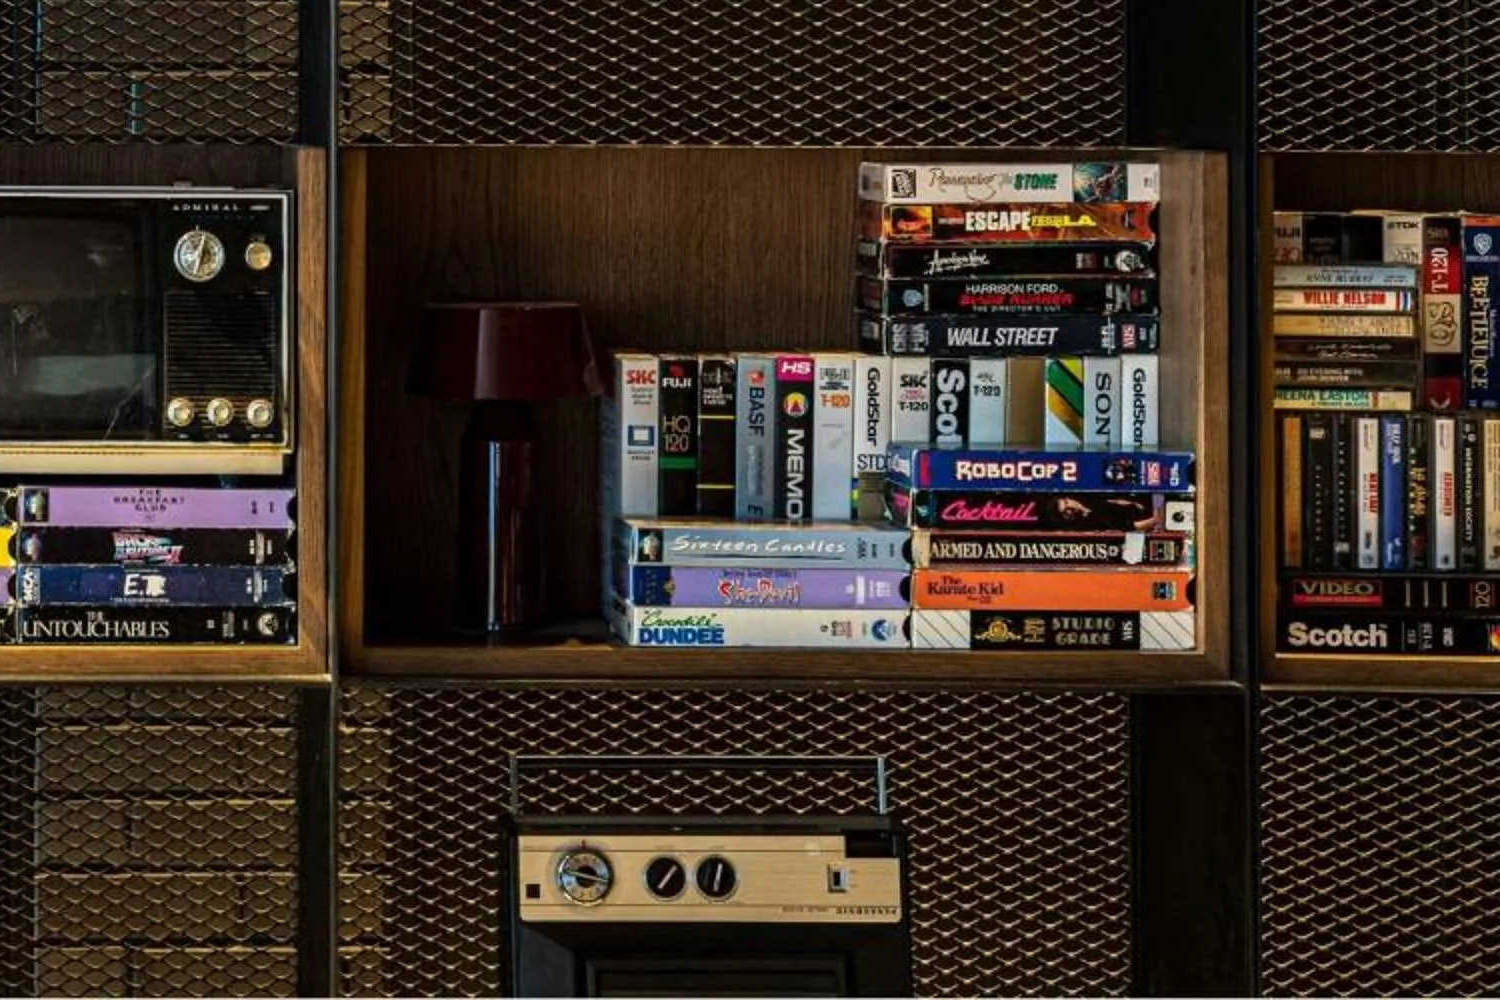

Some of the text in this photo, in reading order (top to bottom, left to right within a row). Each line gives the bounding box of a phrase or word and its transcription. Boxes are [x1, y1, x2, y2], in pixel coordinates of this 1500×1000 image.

[965, 211, 1031, 231] ESCAPE
[1064, 215, 1096, 226] L.A.
[1432, 248, 1448, 293] T-120
[966, 284, 1058, 294] HARRISON FORD
[1303, 291, 1386, 304] WILLIE NELSON
[948, 328, 1058, 346] WALL STREET
[782, 362, 811, 374] HS
[662, 377, 692, 388] FUJI
[821, 394, 850, 408] T-120
[868, 368, 880, 446] GoldStar
[900, 402, 928, 411] T-120
[748, 388, 764, 438] BASF
[664, 416, 690, 434] HQ
[664, 434, 688, 451] 120
[1062, 462, 1077, 480] 2
[941, 500, 1038, 521] Cocktail
[671, 536, 846, 553] Sixteen Candles
[930, 542, 1107, 559] ARMED AND DANGEROUS
[927, 582, 1004, 596] Karate Kid
[941, 576, 962, 586] The
[1302, 583, 1374, 594] VIDEO
[1476, 583, 1490, 608] 120
[23, 620, 169, 638] UNTOUCHABLES
[1052, 618, 1115, 630] STUDIO
[640, 628, 724, 644] DUNDEE
[1056, 632, 1111, 646] GRADE
[1288, 622, 1388, 647] Scotch
